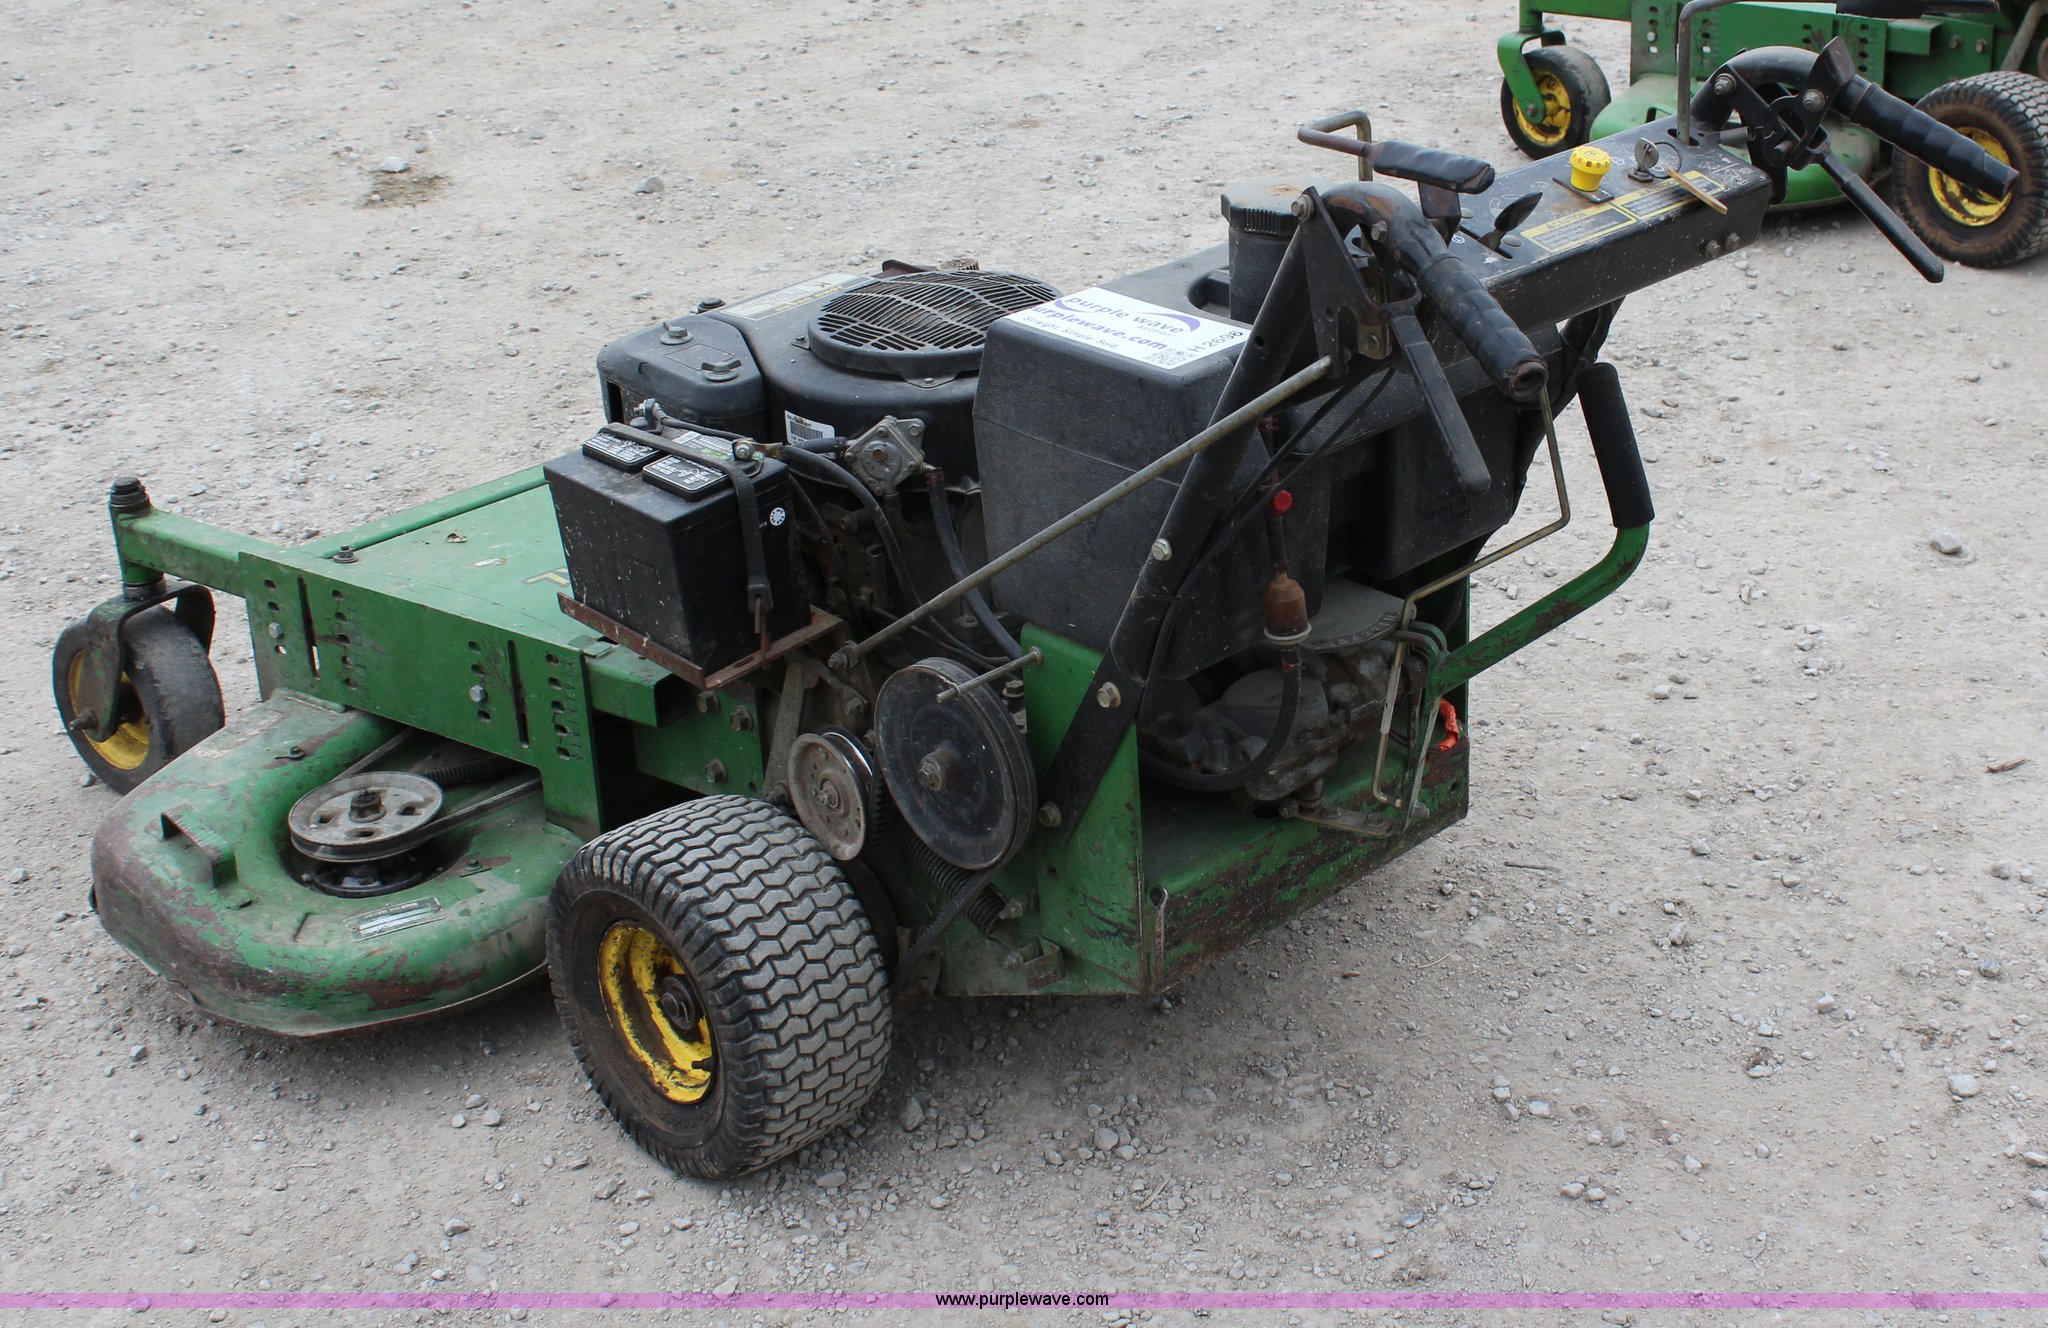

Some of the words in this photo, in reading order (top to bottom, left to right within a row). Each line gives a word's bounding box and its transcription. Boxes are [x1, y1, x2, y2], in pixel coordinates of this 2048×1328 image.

[1032, 307, 1168, 350] urplewave.com
[1066, 298, 1128, 318] purple
[1133, 317, 1184, 333] wave
